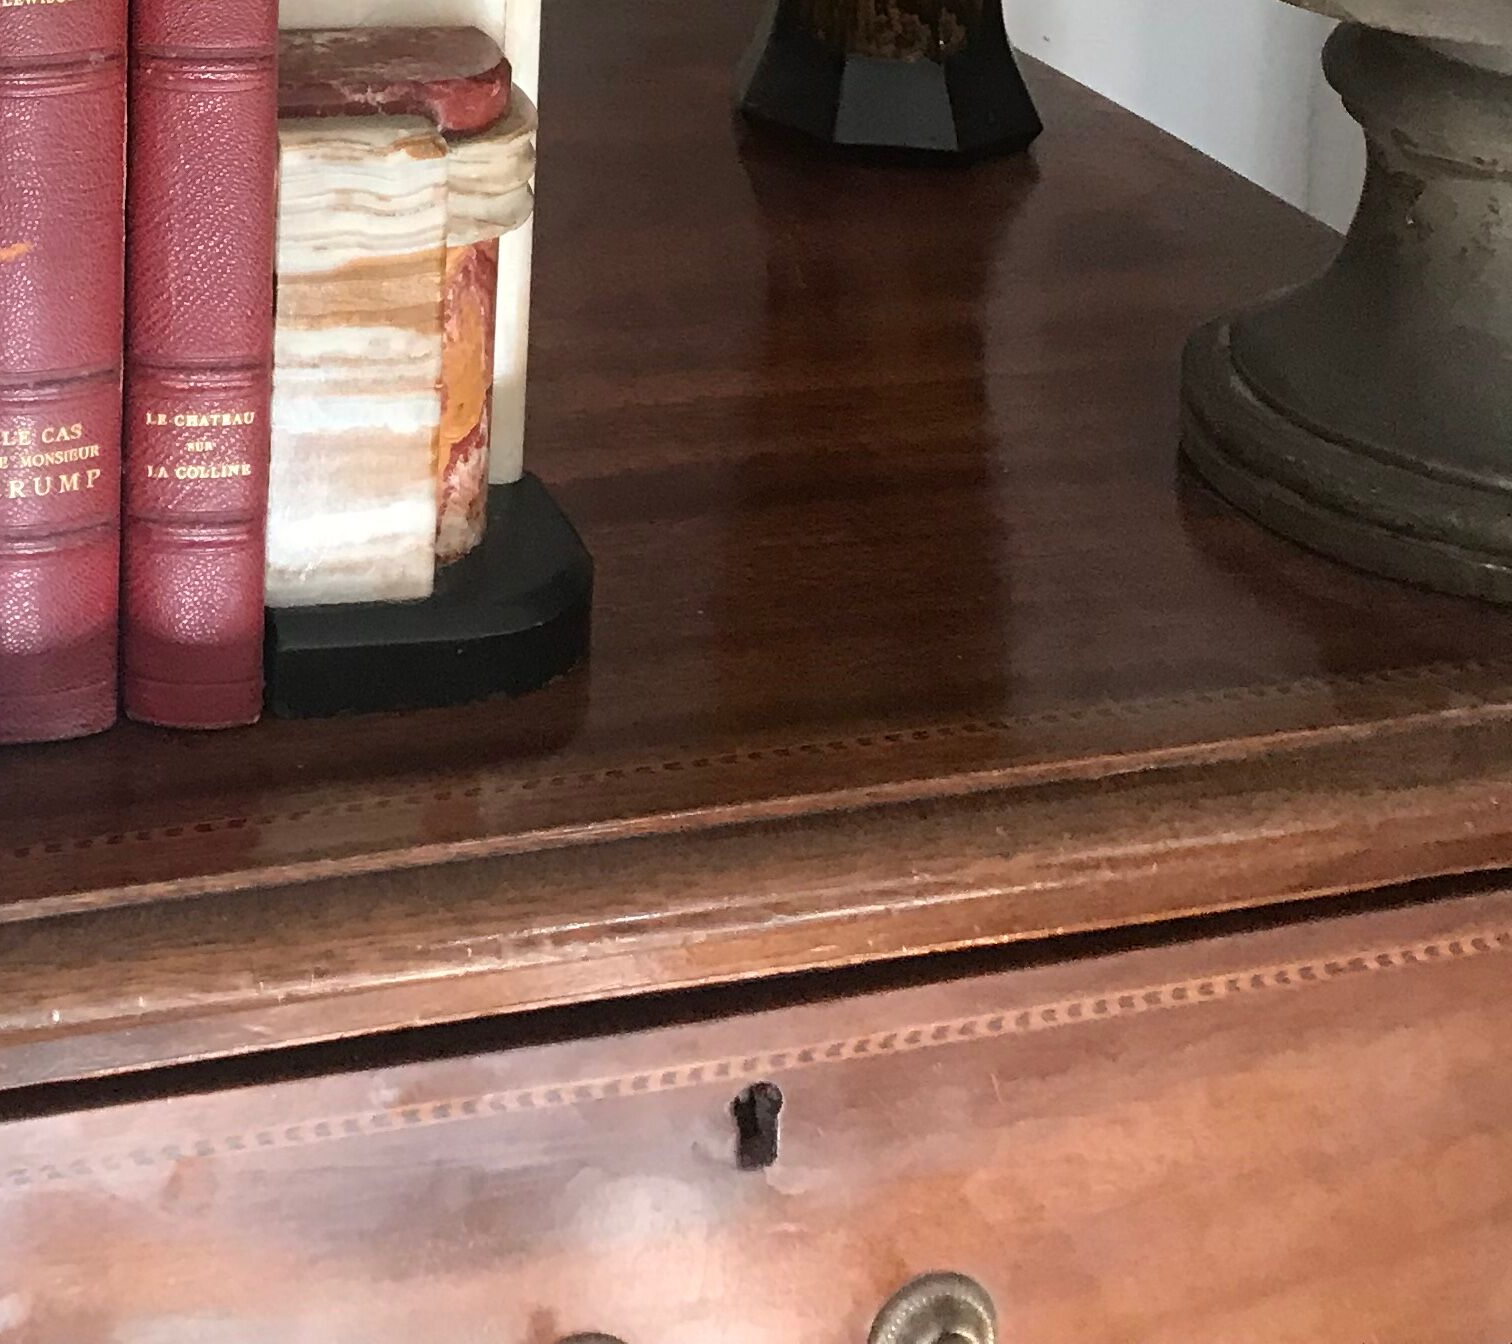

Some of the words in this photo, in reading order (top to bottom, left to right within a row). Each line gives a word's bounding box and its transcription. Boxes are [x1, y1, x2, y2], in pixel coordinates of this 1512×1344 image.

[145, 412, 168, 426] LE
[173, 411, 256, 427] CHATEAU
[1, 430, 32, 447] LE
[41, 423, 84, 444] CAS
[20, 443, 101, 468] MONSIEUR
[147, 464, 169, 479] LA
[175, 463, 252, 480] COLLINE
